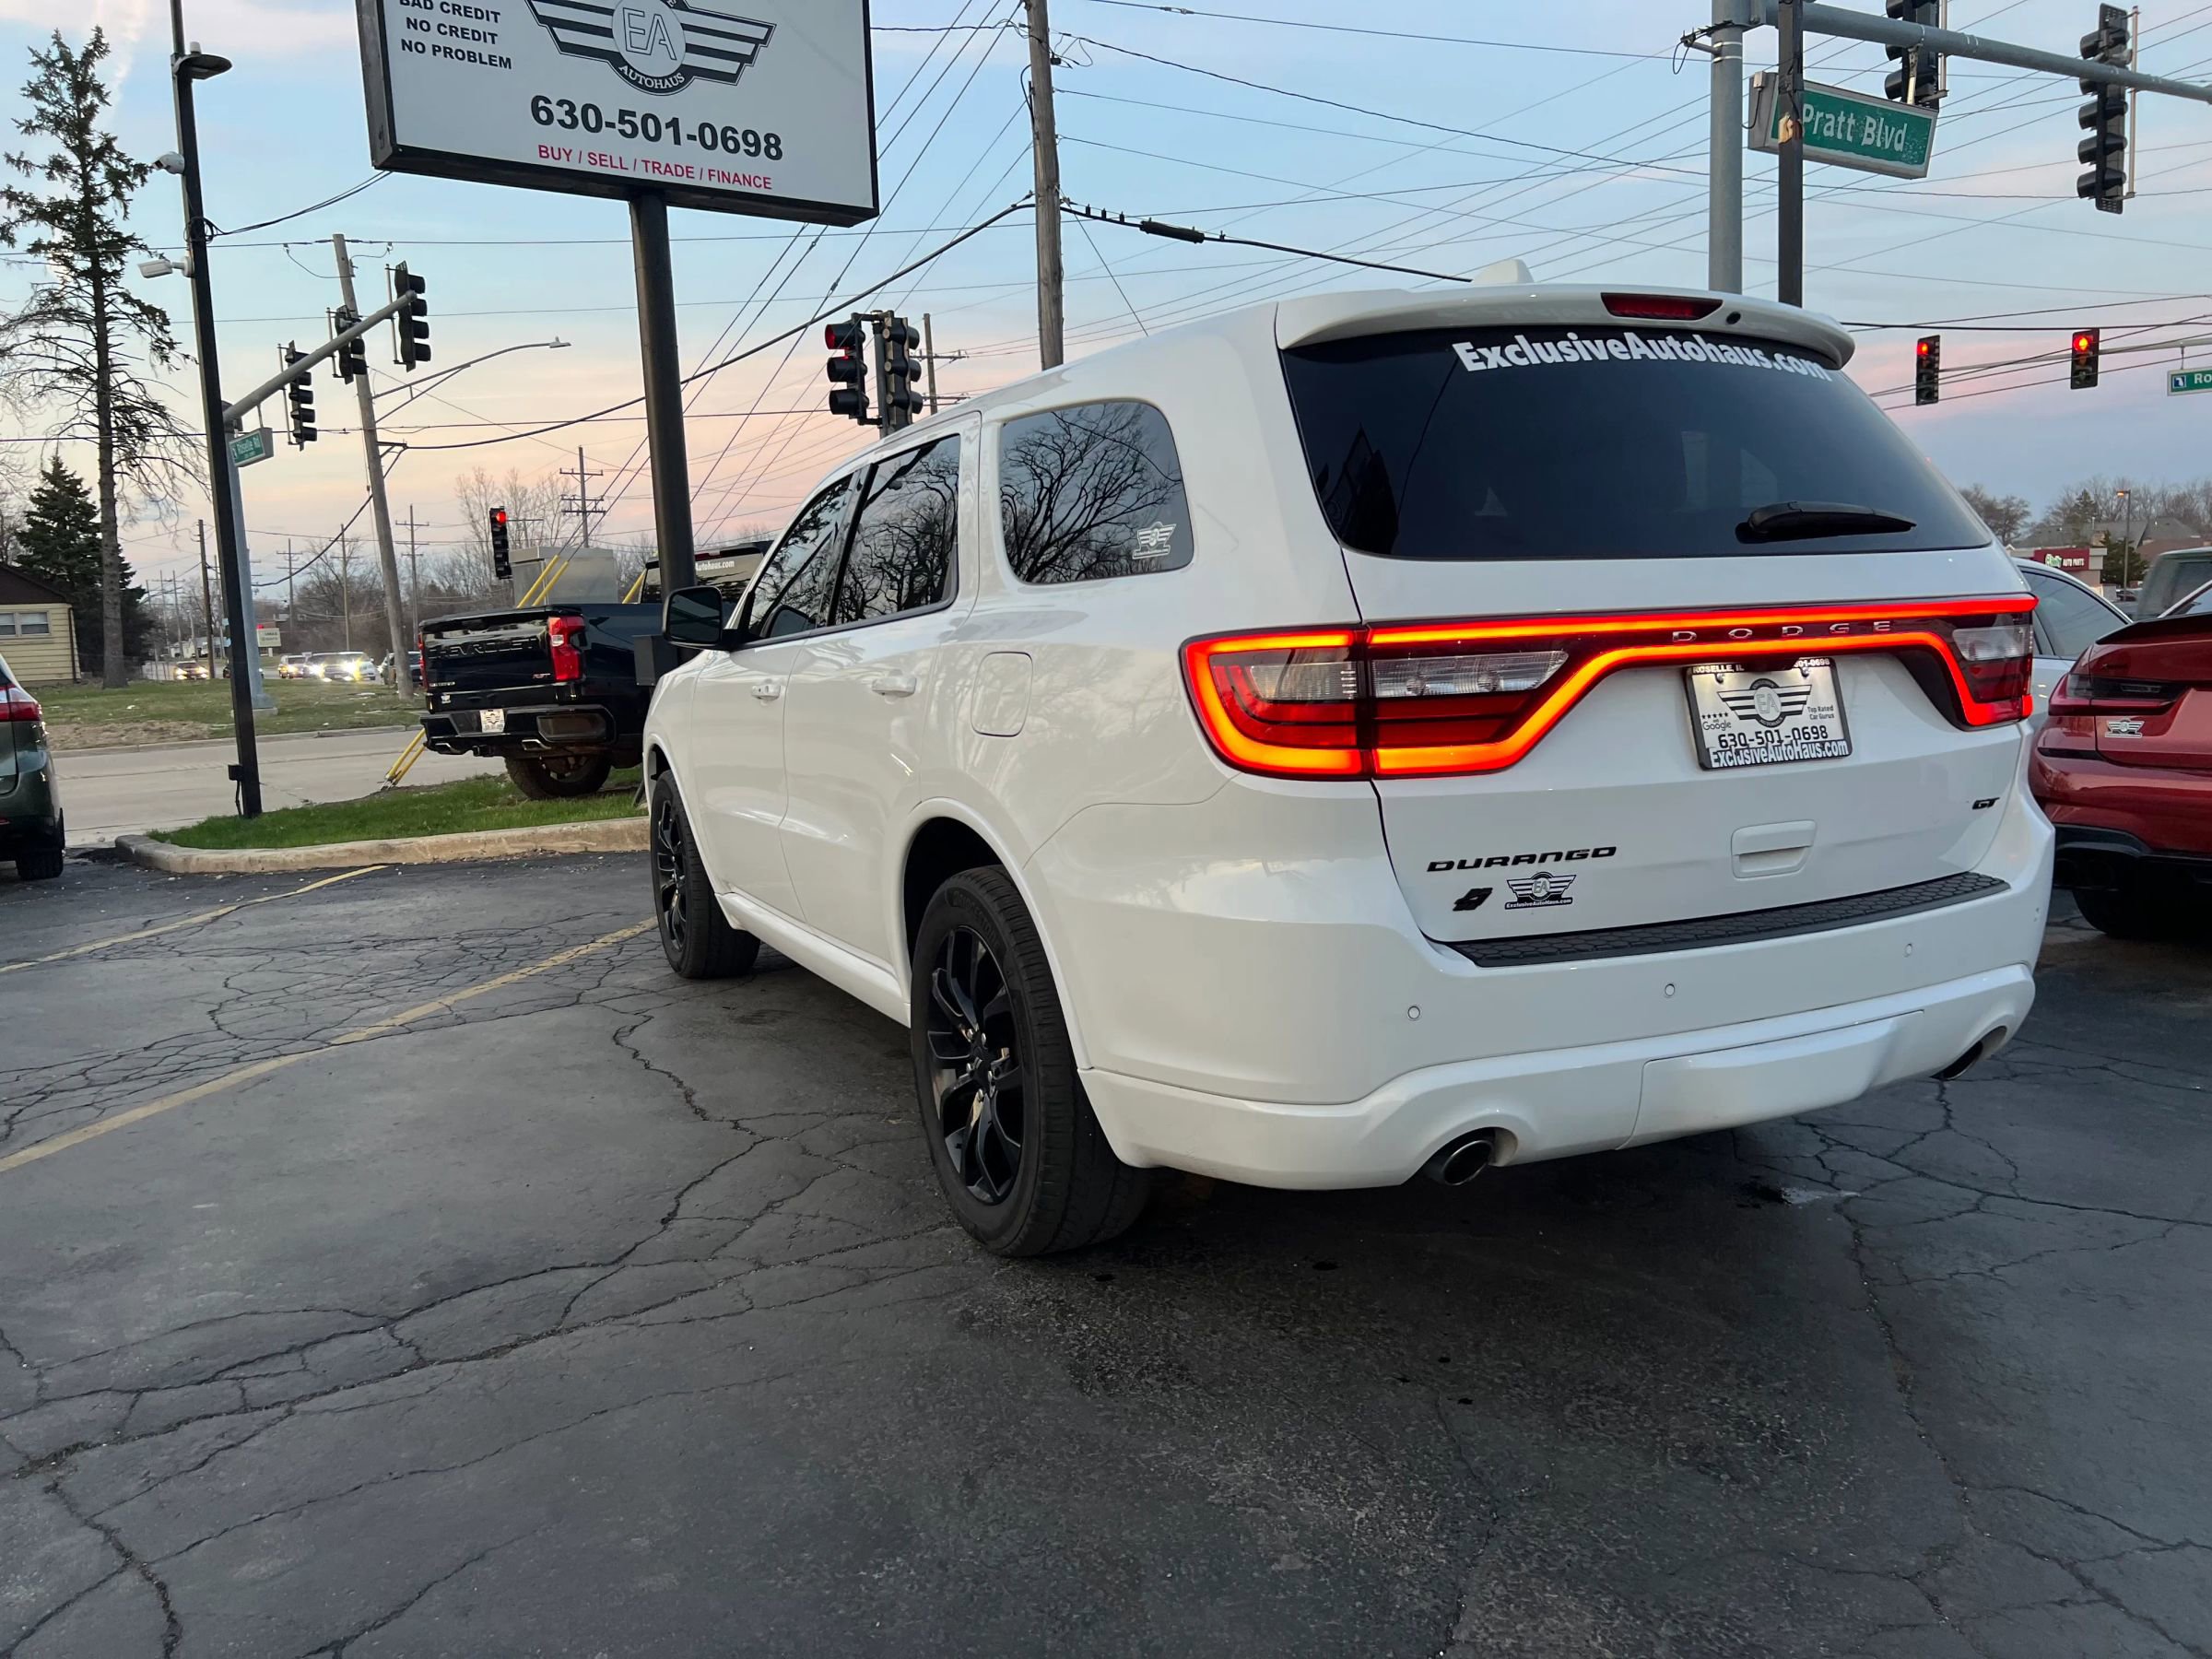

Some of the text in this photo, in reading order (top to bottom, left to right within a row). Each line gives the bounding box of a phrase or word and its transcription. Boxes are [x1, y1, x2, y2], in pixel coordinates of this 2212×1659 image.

[440, 2, 500, 23] CREDIT
[406, 17, 498, 45] NO CREDIT
[623, 7, 677, 61] EA
[401, 39, 512, 69] NO PROBLEM
[618, 65, 685, 89] AUTOHAUS
[531, 95, 782, 160] 630-501-0698
[1803, 103, 1908, 152] Pratt Blvd
[538, 145, 572, 162] BUY
[587, 152, 629, 171] SELL
[641, 159, 695, 180] TRADE
[708, 169, 772, 190] FINANCE
[1452, 332, 1832, 382] ExclusiveAutohaus.com
[1672, 621, 1890, 641] DODGE
[1702, 720, 1732, 731] Google
[1718, 725, 1829, 748] 630-501-0698
[1709, 738, 1849, 768] ExclusiveAutoHaus.com
[1972, 797, 2000, 810] GT
[1427, 846, 1617, 872] DURANGO
[1533, 880, 1548, 894] EA
